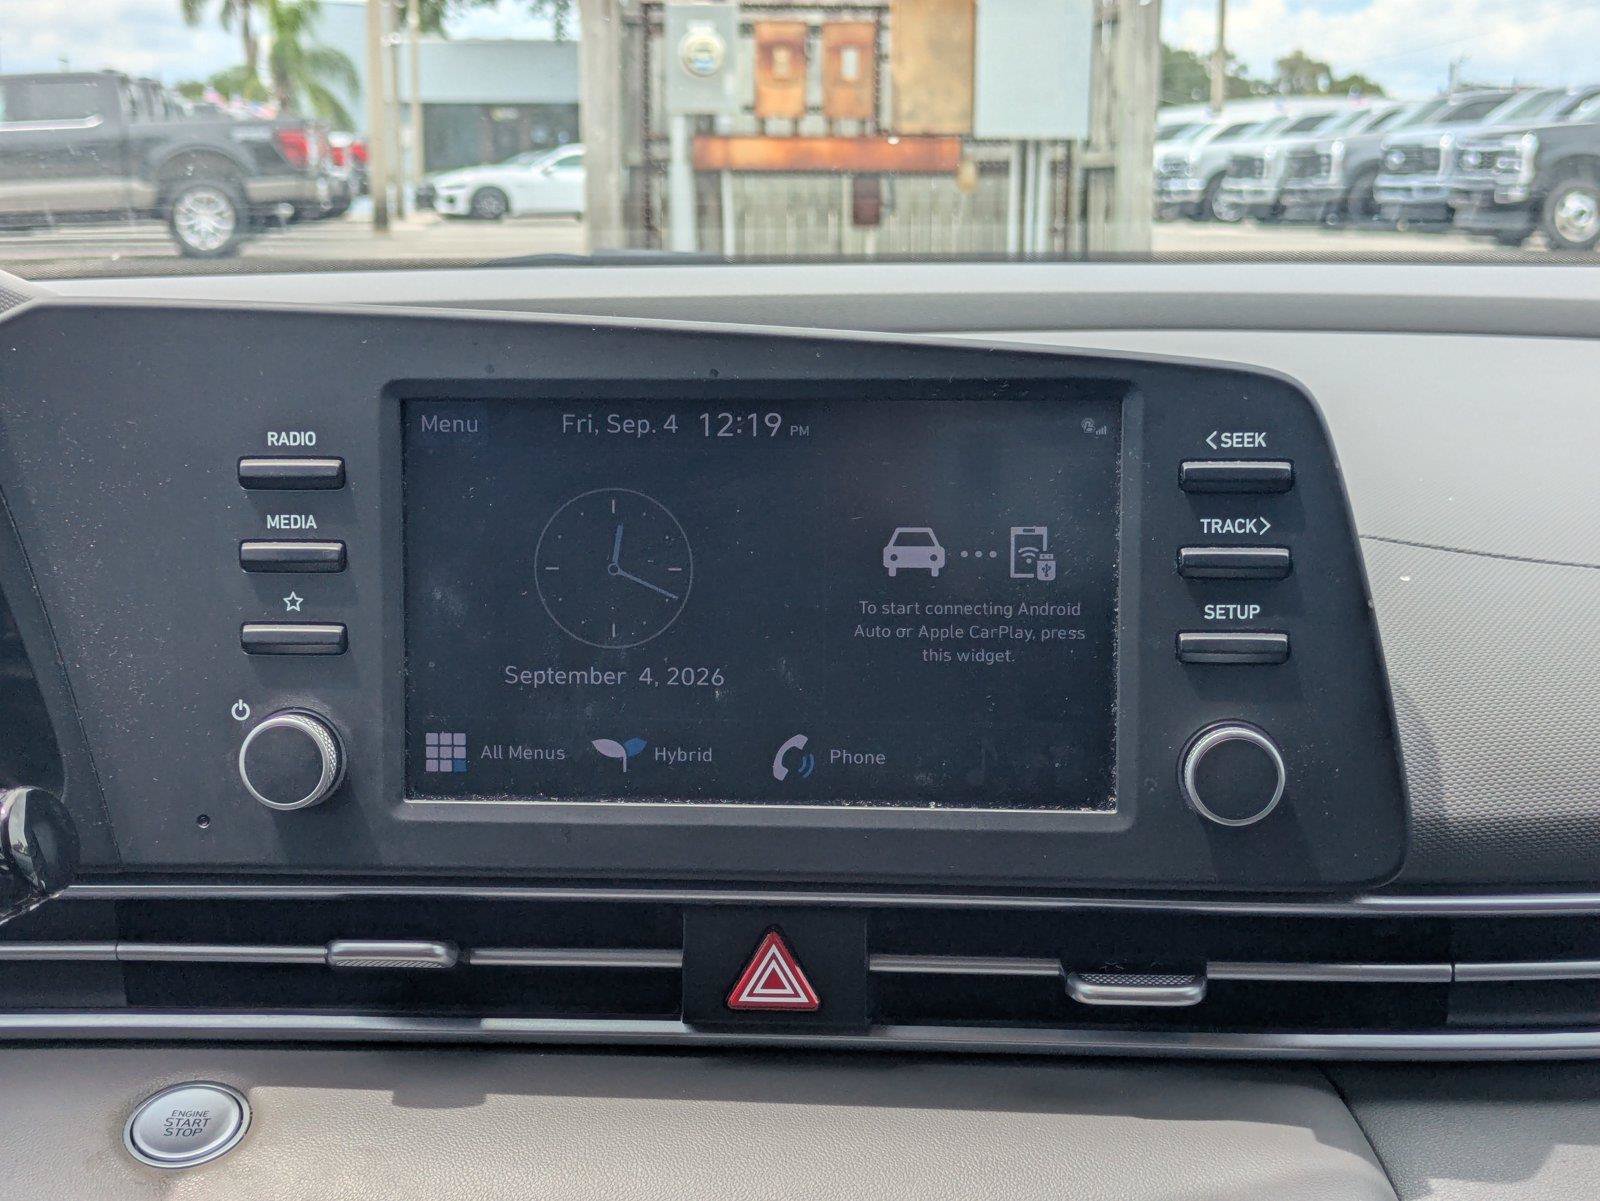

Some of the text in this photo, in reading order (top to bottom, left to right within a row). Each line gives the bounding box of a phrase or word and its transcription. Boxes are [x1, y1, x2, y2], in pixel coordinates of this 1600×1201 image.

[421, 414, 479, 434] Menu
[562, 412, 810, 438] Fri, Sep. 4 12:19 PM
[267, 431, 317, 446] RADIO
[1220, 432, 1267, 448] SEEK
[266, 515, 317, 530] MEDIA
[1200, 518, 1257, 534] TRACK
[859, 601, 1082, 620] To start connecting Android
[1204, 605, 1260, 620] SETUP
[854, 625, 1086, 643] Auto or Apple CarPlay, press
[922, 648, 1016, 668] this widget.
[504, 666, 725, 688] September 4, 2026
[480, 745, 566, 761] All Menus
[654, 747, 713, 764] Hybrid
[829, 749, 887, 765] Phone
[171, 1109, 210, 1118] ENGINE
[163, 1118, 212, 1127] START
[163, 1128, 203, 1137] STOP
